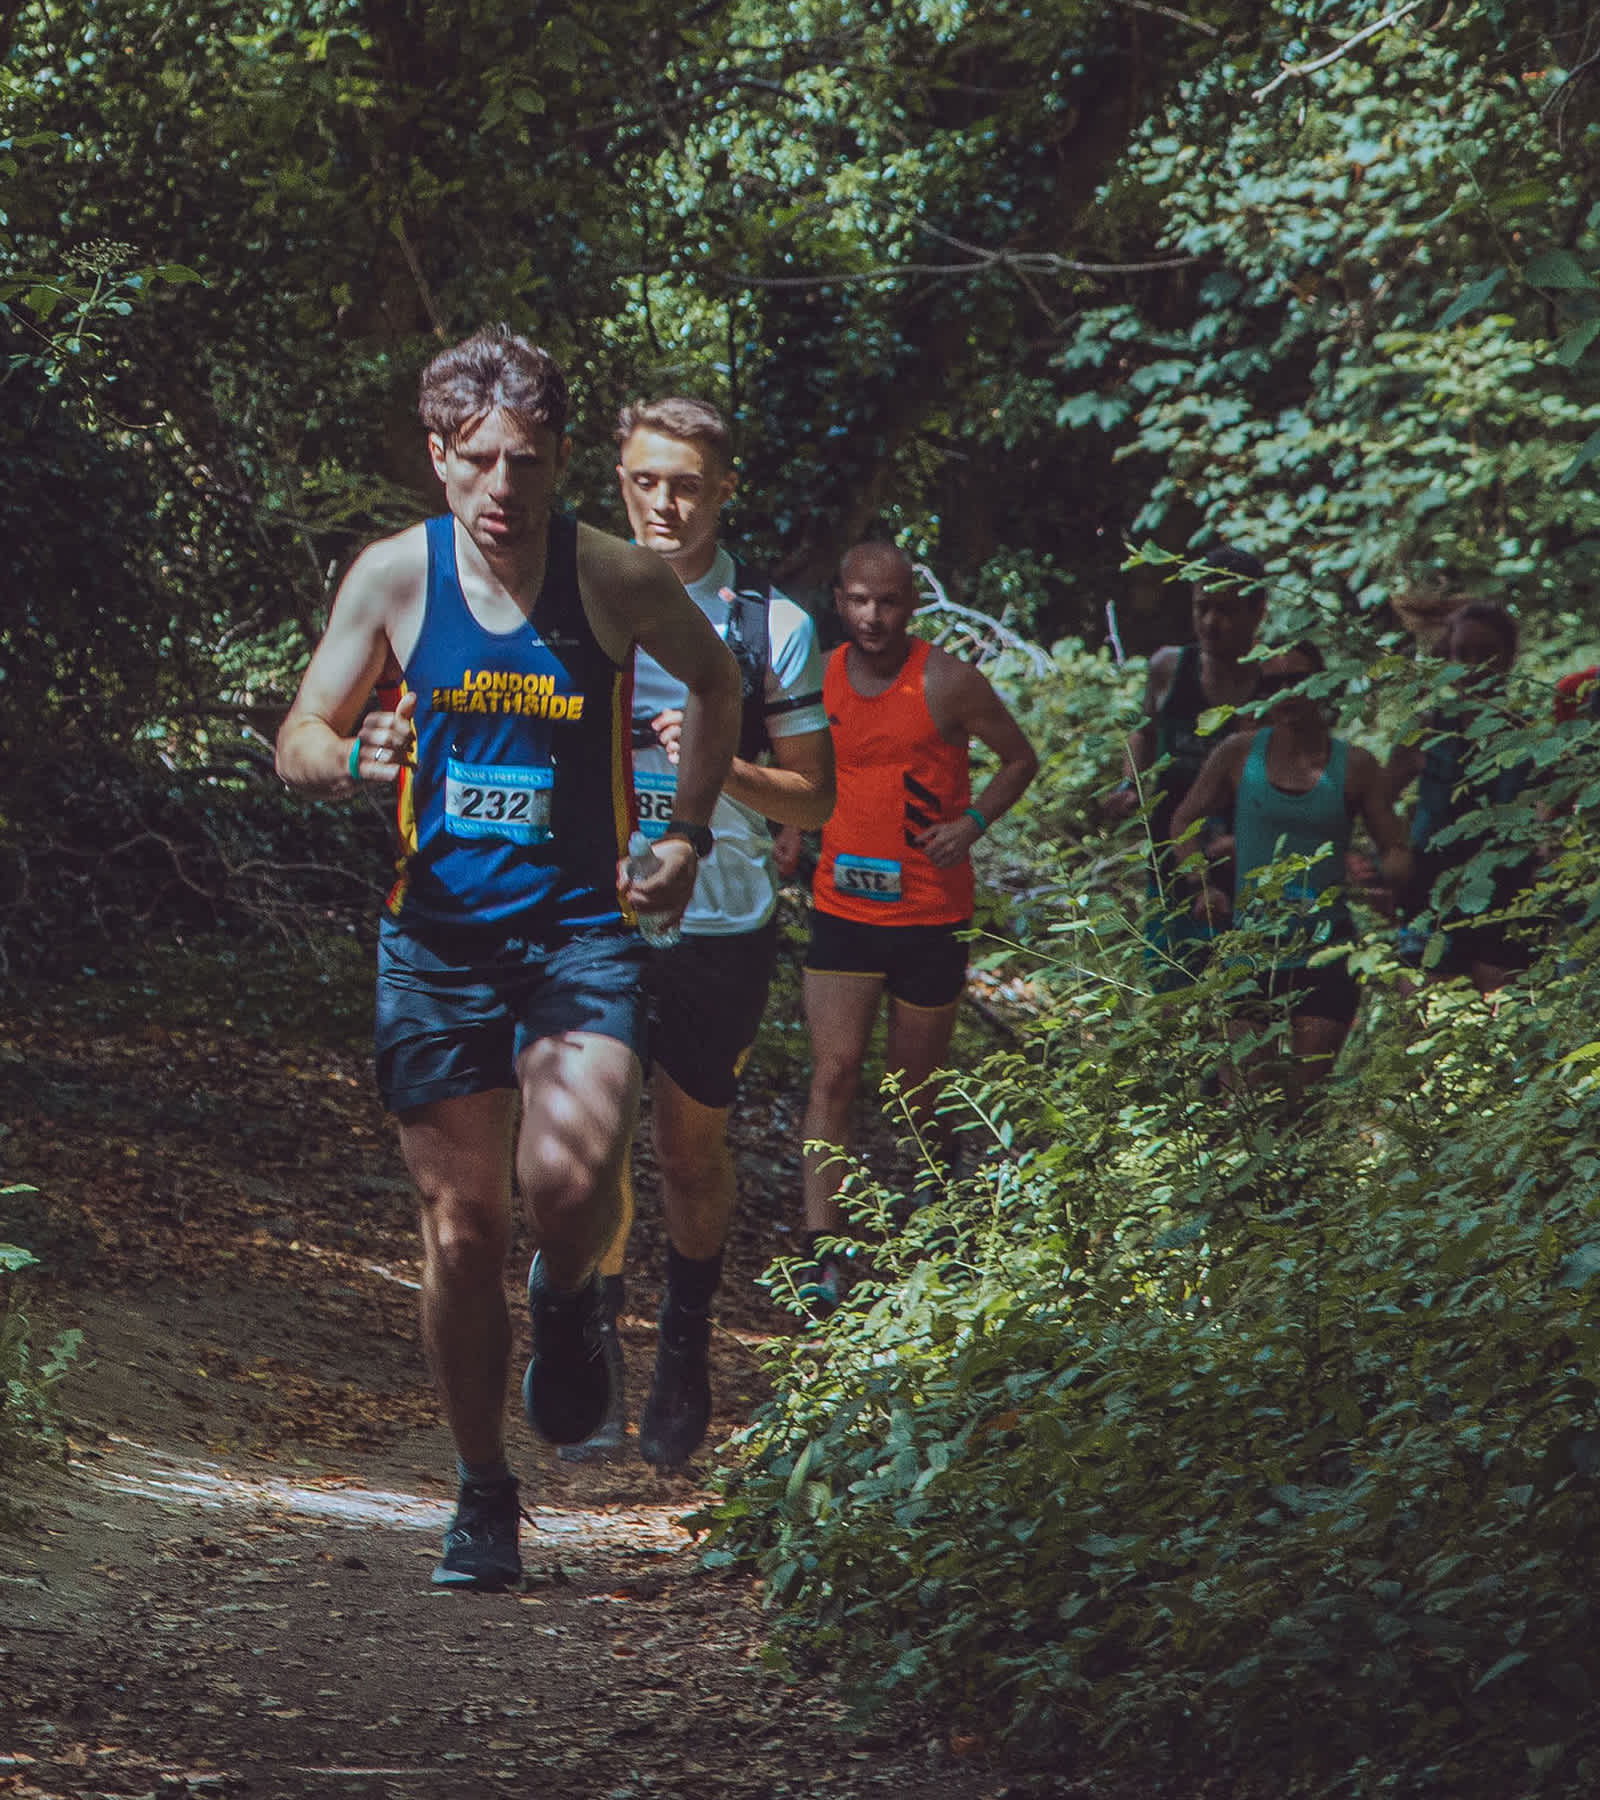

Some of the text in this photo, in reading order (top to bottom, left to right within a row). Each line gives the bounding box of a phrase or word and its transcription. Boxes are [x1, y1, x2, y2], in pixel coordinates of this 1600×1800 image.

[463, 669, 555, 695] LONDON
[432, 688, 584, 720] HEATHSIDE
[461, 787, 530, 820] 232
